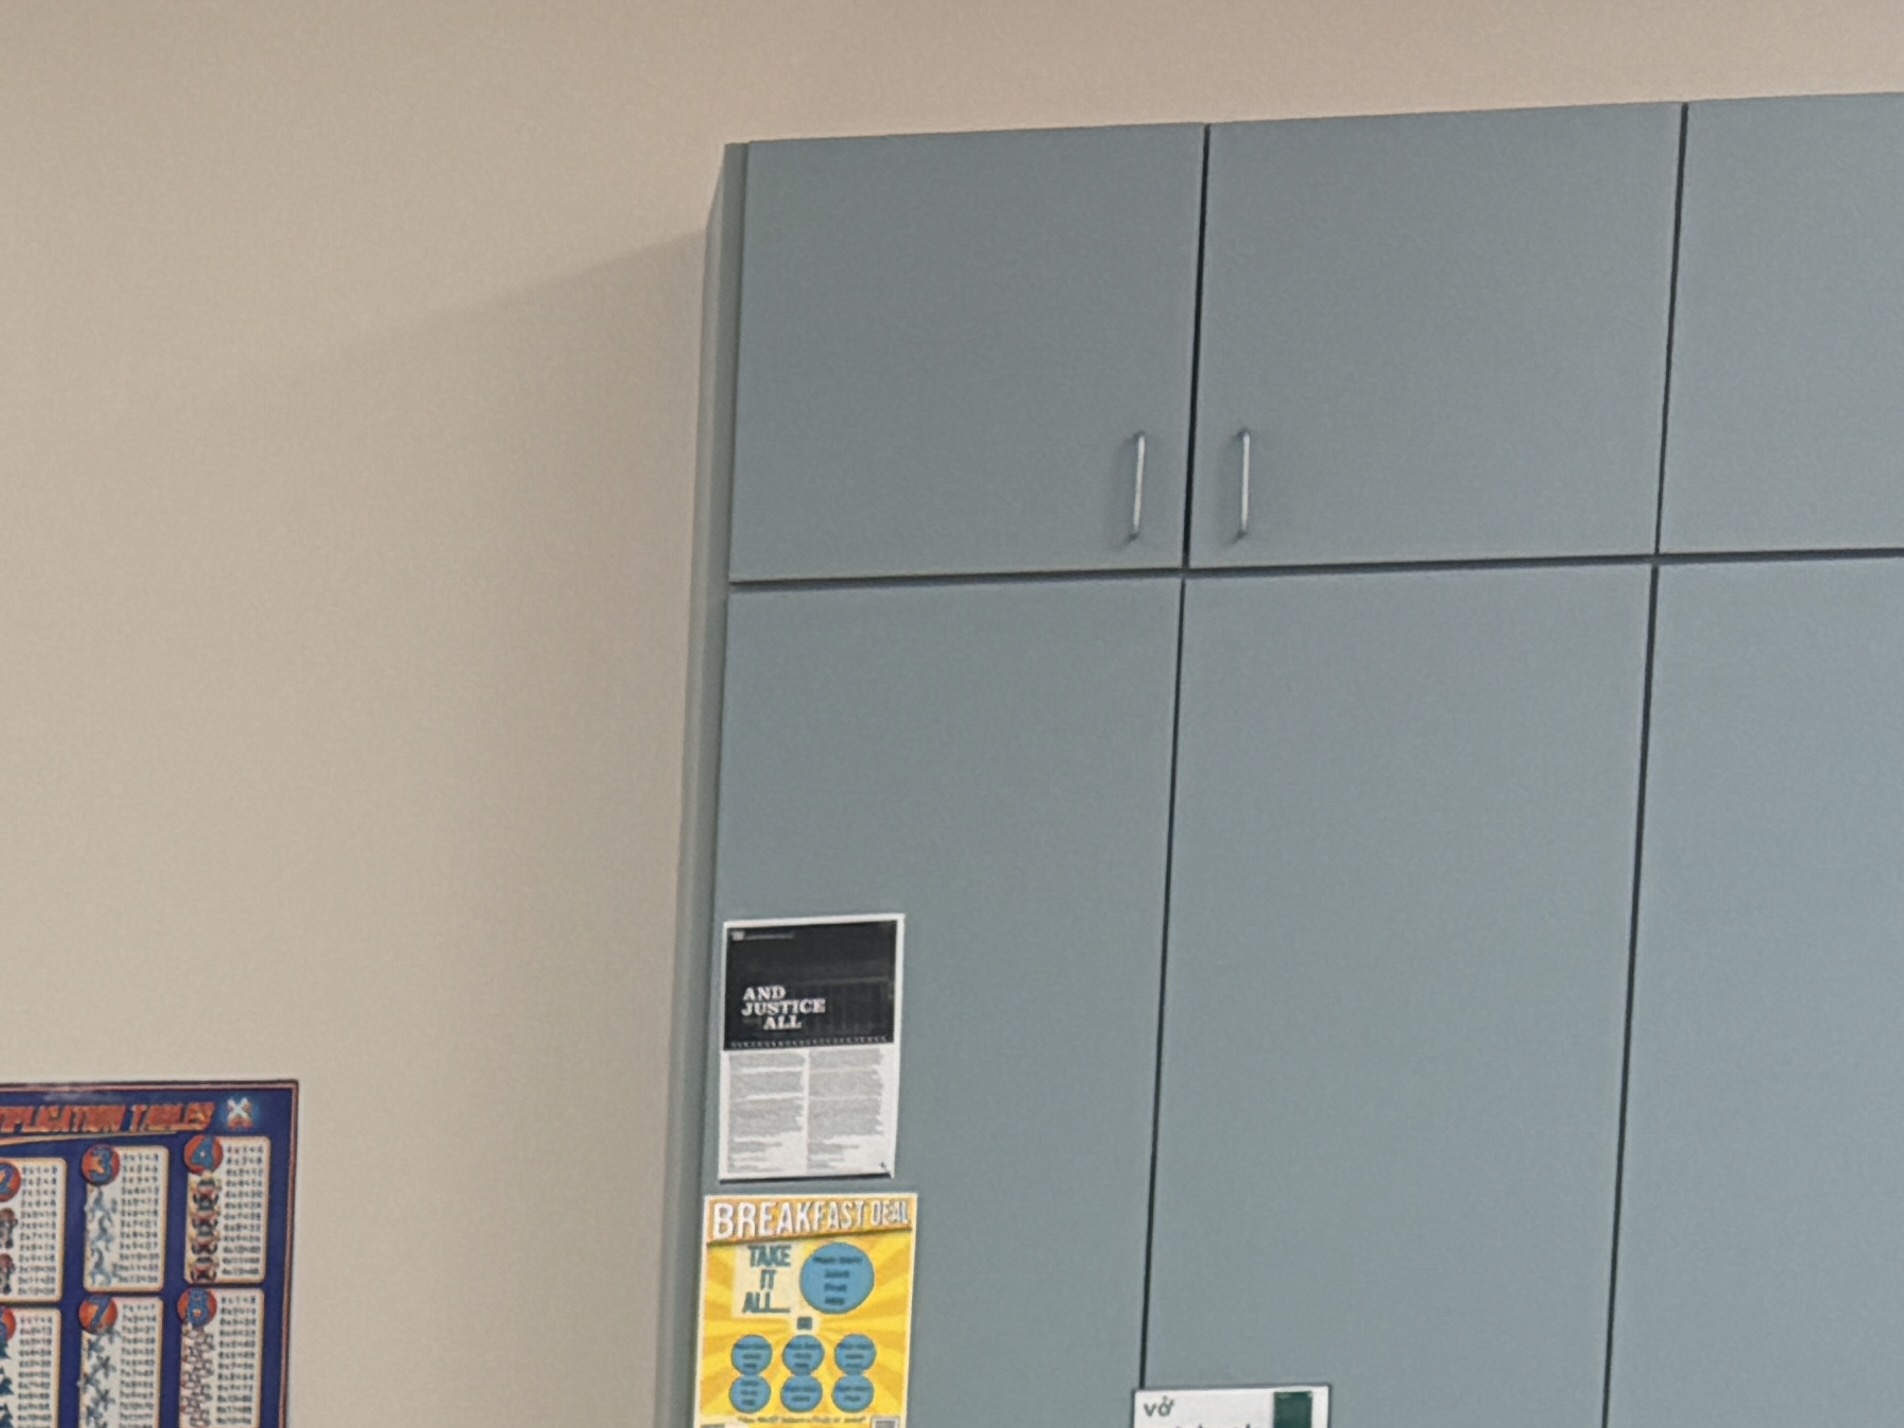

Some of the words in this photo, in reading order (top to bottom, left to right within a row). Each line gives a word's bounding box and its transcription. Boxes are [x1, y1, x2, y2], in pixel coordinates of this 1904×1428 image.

[743, 985, 786, 1001] AND
[741, 998, 826, 1016] JUSTICE
[763, 1016, 802, 1030] ALL
[713, 1200, 864, 1240] BREAKFAST
[871, 1200, 909, 1226] DEAL
[748, 1245, 791, 1267] TAKE
[760, 1270, 776, 1290] IT
[1144, 1396, 1174, 1417] vở
